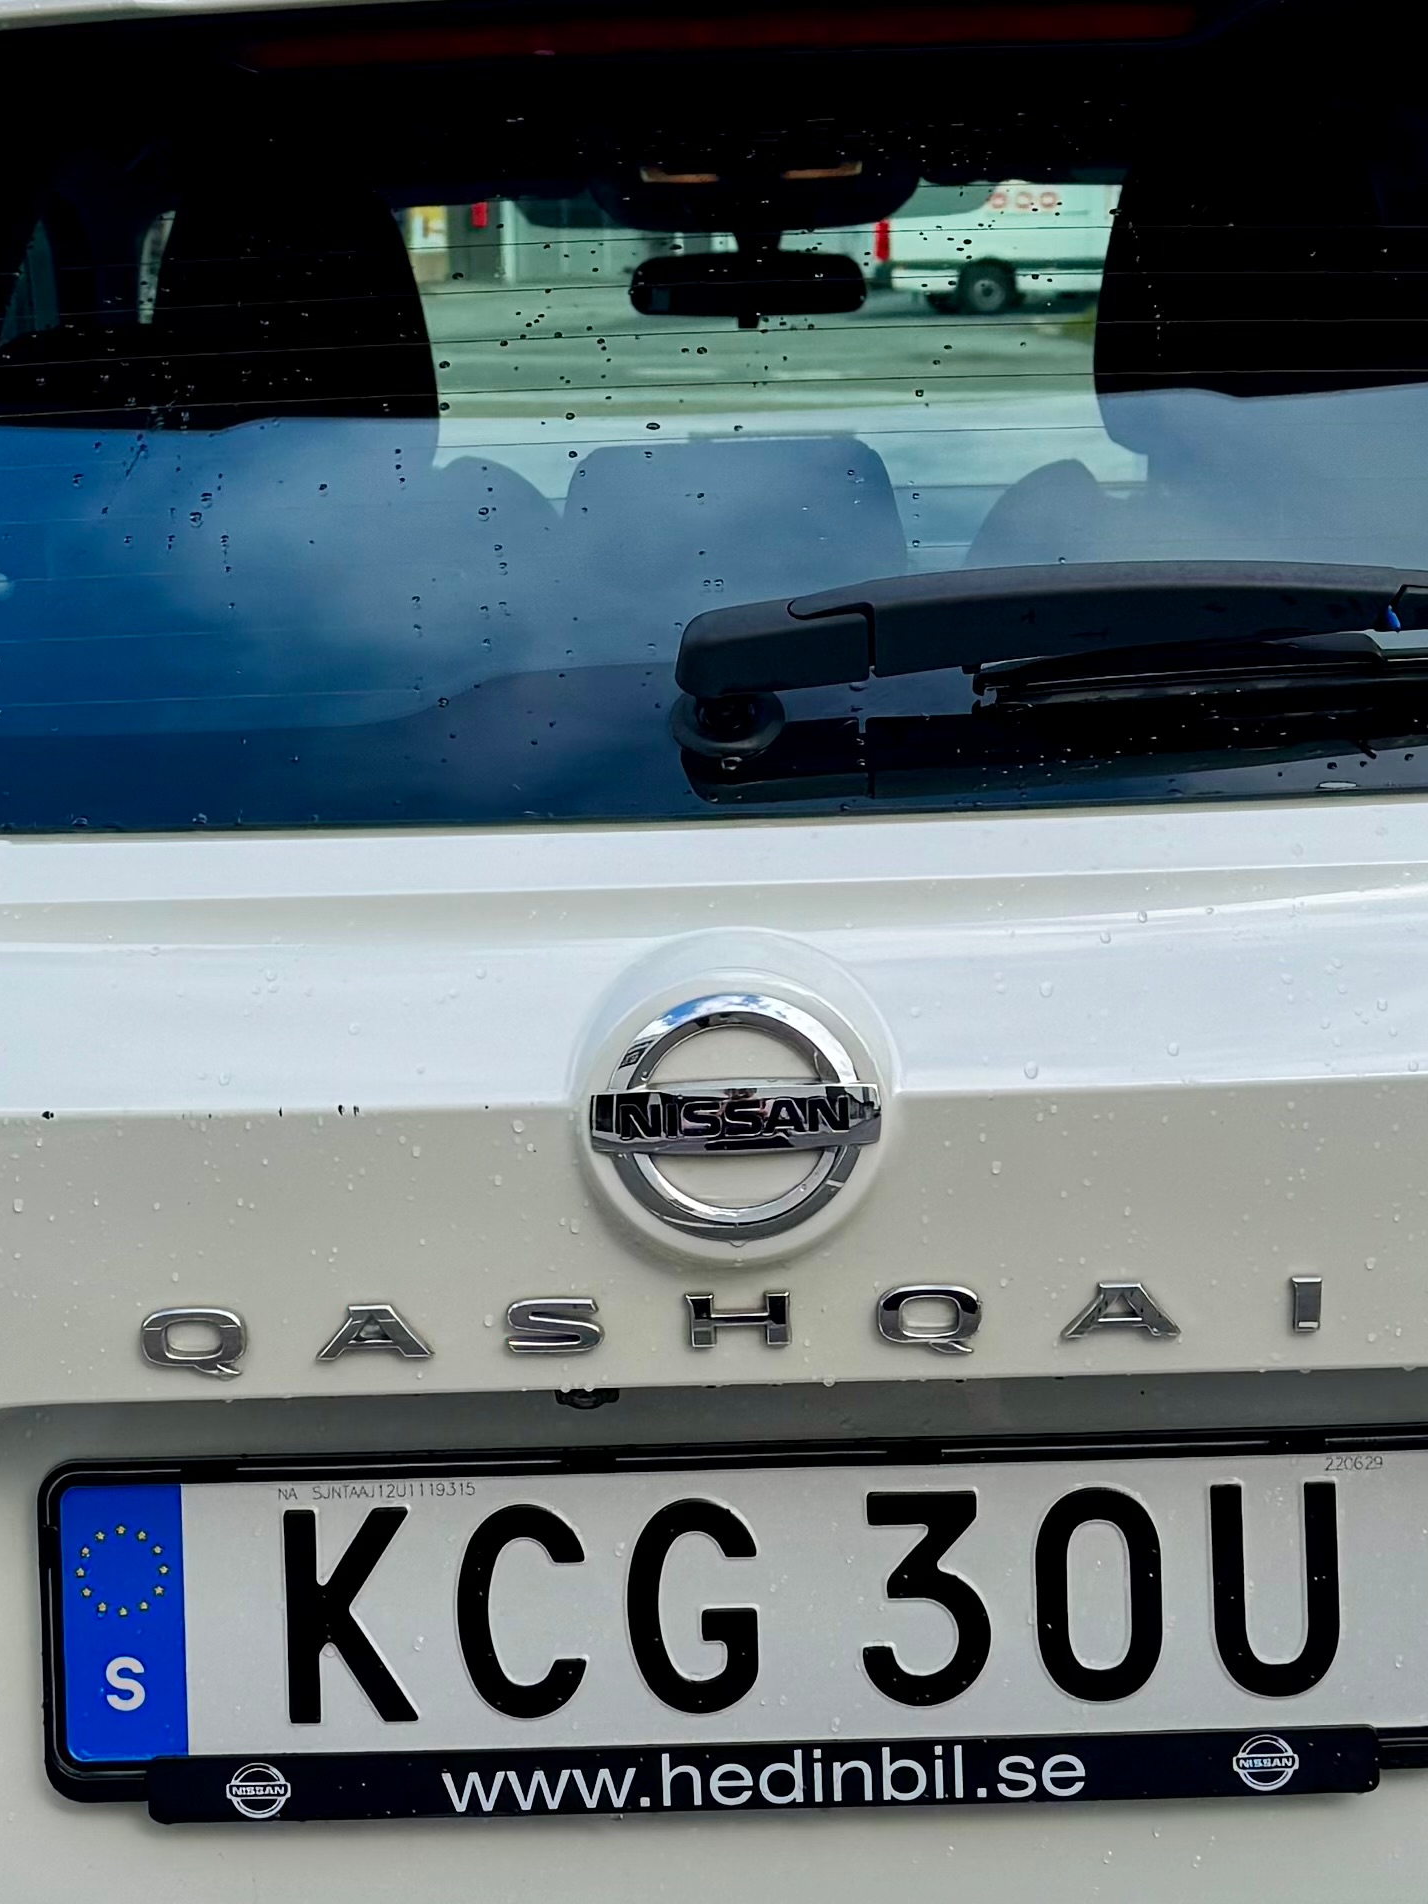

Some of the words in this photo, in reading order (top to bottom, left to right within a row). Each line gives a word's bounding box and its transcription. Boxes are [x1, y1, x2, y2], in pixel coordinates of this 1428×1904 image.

[619, 1096, 851, 1140] NISSAN
[140, 1276, 1323, 1379] QASHQAI
[1324, 1455, 1384, 1472] 220629
[278, 1487, 298, 1500] NA
[282, 1497, 759, 1724] KCG
[862, 1481, 1340, 1707] 30U
[105, 1656, 146, 1711] S
[441, 1744, 1086, 1813] www.hedinbil.se
[1239, 1757, 1293, 1768] NISSAN
[232, 1786, 285, 1796] NISSAN
